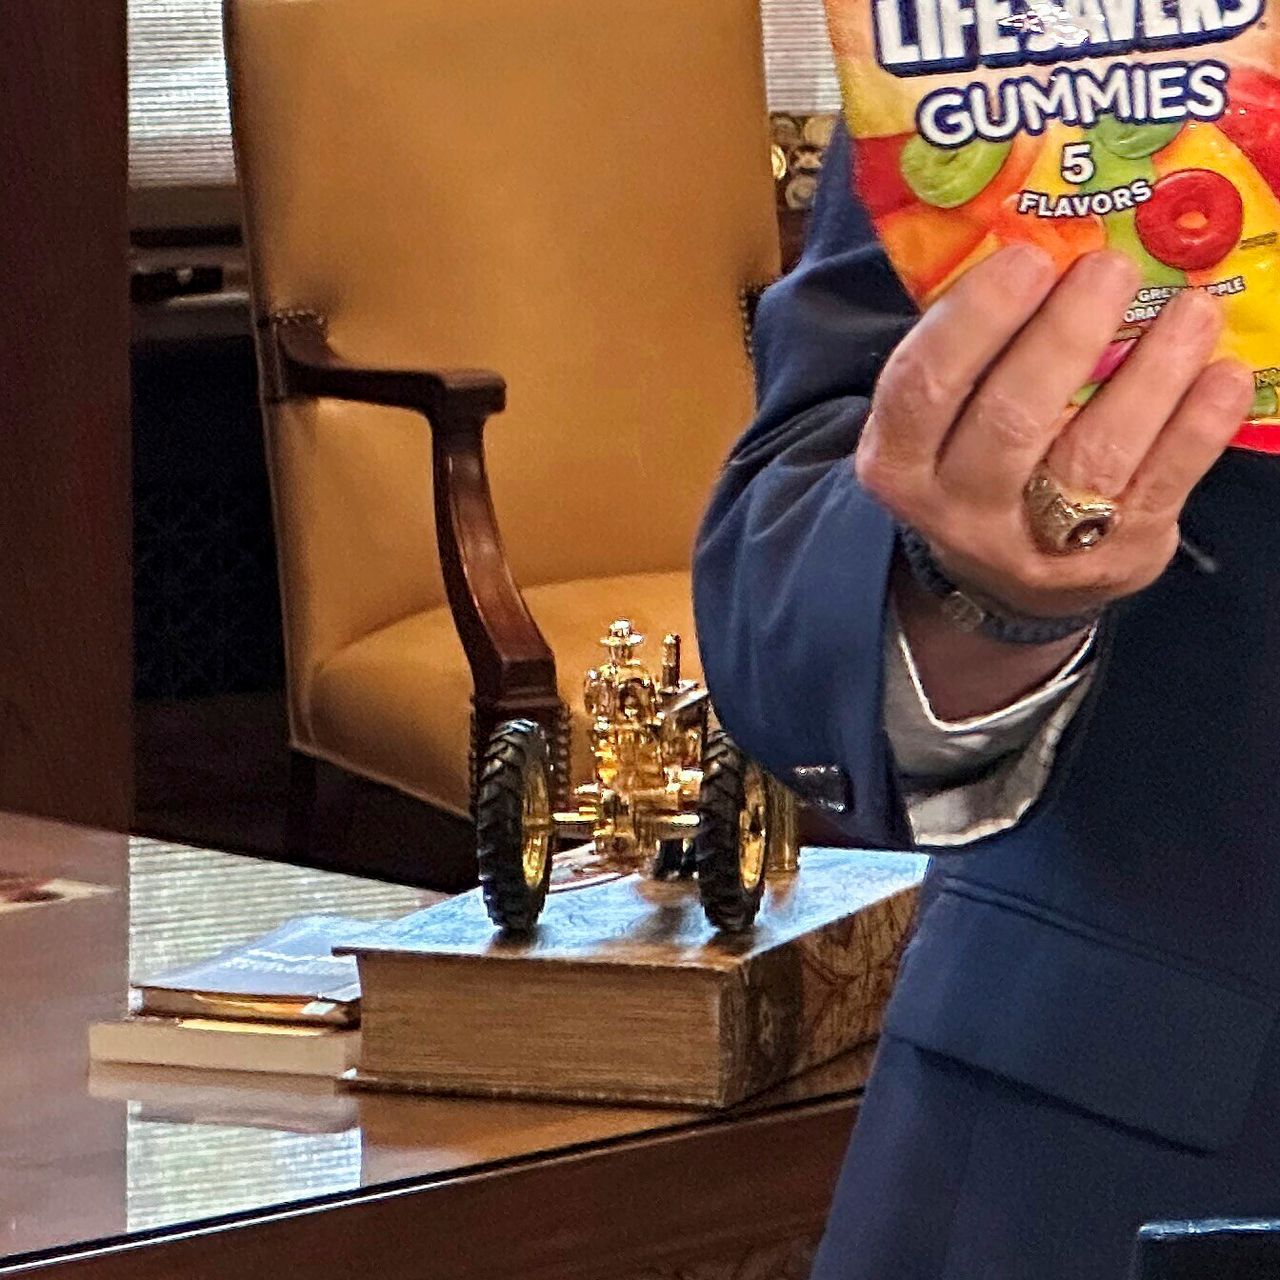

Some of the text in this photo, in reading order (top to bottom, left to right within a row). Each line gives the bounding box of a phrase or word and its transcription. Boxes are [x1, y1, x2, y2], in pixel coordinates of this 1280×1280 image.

[919, 64, 1228, 147] GUMMIES
[1060, 142, 1095, 184] 5
[1018, 179, 1153, 217] FLAVORS
[1137, 287, 1180, 302] GRE
